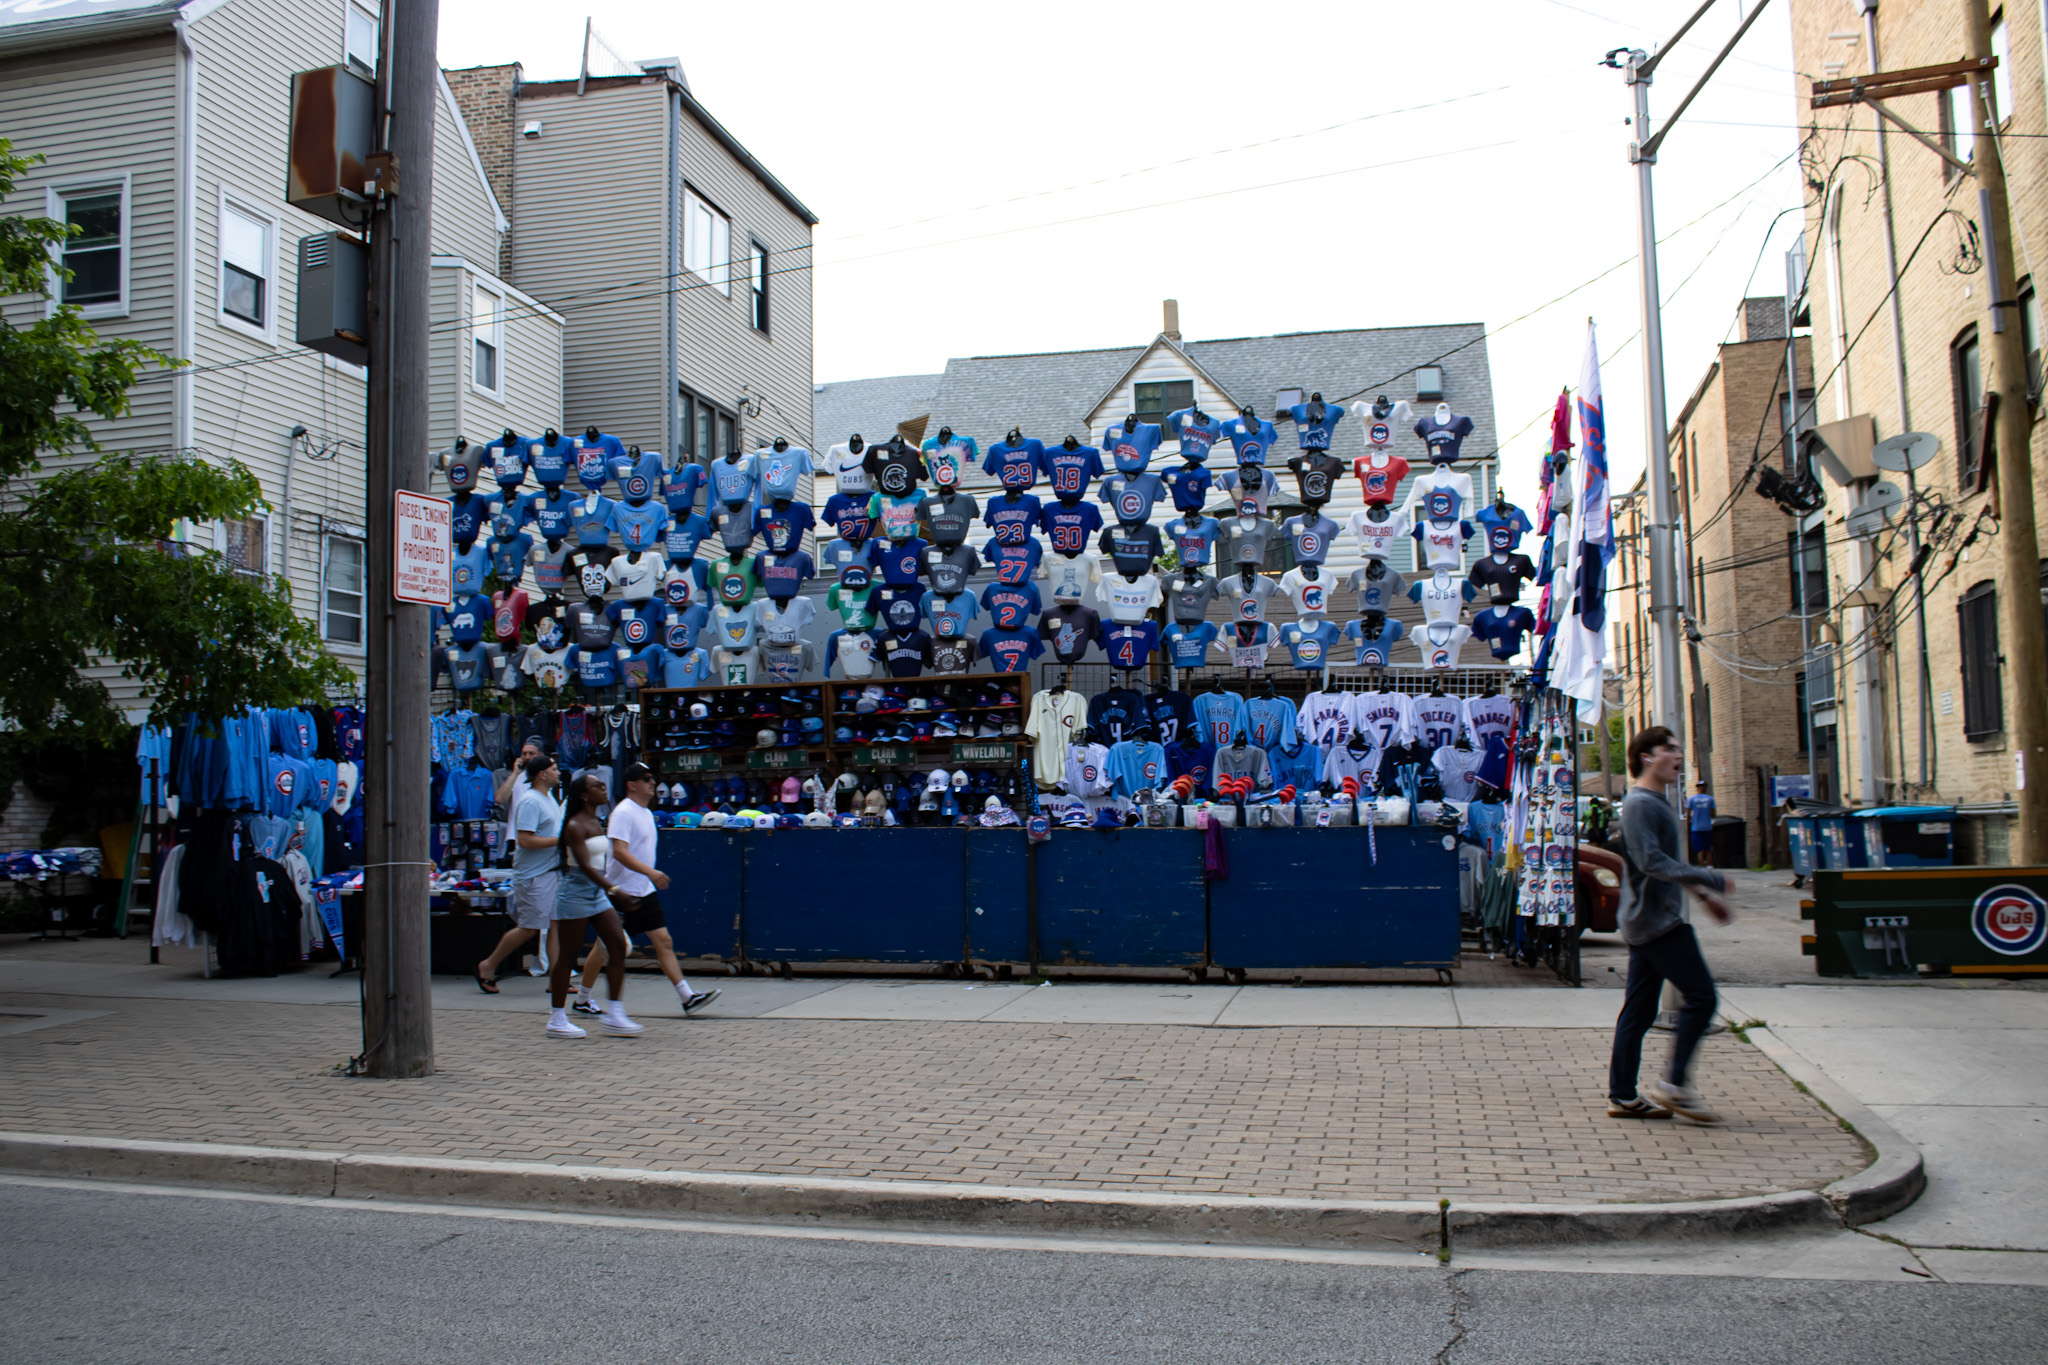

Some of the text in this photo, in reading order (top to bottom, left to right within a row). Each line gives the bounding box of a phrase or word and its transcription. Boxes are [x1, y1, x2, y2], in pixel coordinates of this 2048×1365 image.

[1183, 427, 1212, 448] CUBS
[505, 464, 523, 475] SIDE
[842, 475, 863, 484] CUBS
[1003, 463, 1033, 487] 29
[1055, 467, 1080, 491] 18
[719, 474, 747, 490] CUBS
[400, 501, 448, 525] DIESEL ENGINE
[411, 523, 437, 543] IDLING
[630, 524, 641, 545] 4
[841, 518, 869, 541] 27
[996, 523, 1025, 544] 23
[1053, 526, 1082, 550] 30
[1363, 525, 1394, 537] CHICAGO
[1002, 547, 1029, 558] SUZUKI
[1179, 537, 1206, 549] CUBS
[403, 542, 445, 565] PROHIBITED
[765, 566, 798, 580] CHICAGO
[999, 560, 1028, 583] 27
[1427, 590, 1456, 600] CUBS
[933, 611, 962, 621] CHICAGO
[1000, 606, 1016, 628] 2
[768, 654, 799, 666] CHICAGO
[887, 649, 922, 662] WRIGLEYVILLE
[933, 648, 966, 666] CHICAGO CUBS
[1004, 653, 1020, 672] 7
[1119, 640, 1134, 665] 4
[1236, 648, 1261, 658] CHICAGO
[536, 661, 563, 672] CHICAGO
[1420, 711, 1457, 724] TUCKER
[1110, 723, 1122, 746] 4
[1158, 718, 1179, 746] 27
[1211, 722, 1229, 744] 18
[1254, 724, 1266, 746] 4
[1322, 727, 1335, 750] 4
[1379, 724, 1393, 748] 7
[1426, 728, 1453, 748] 30
[678, 755, 702, 766] CLARK
[764, 752, 789, 763] CLARK
[871, 748, 896, 760] CLARK
[962, 747, 1006, 759] WAVELAND
[1986, 897, 2034, 941] CUBS
